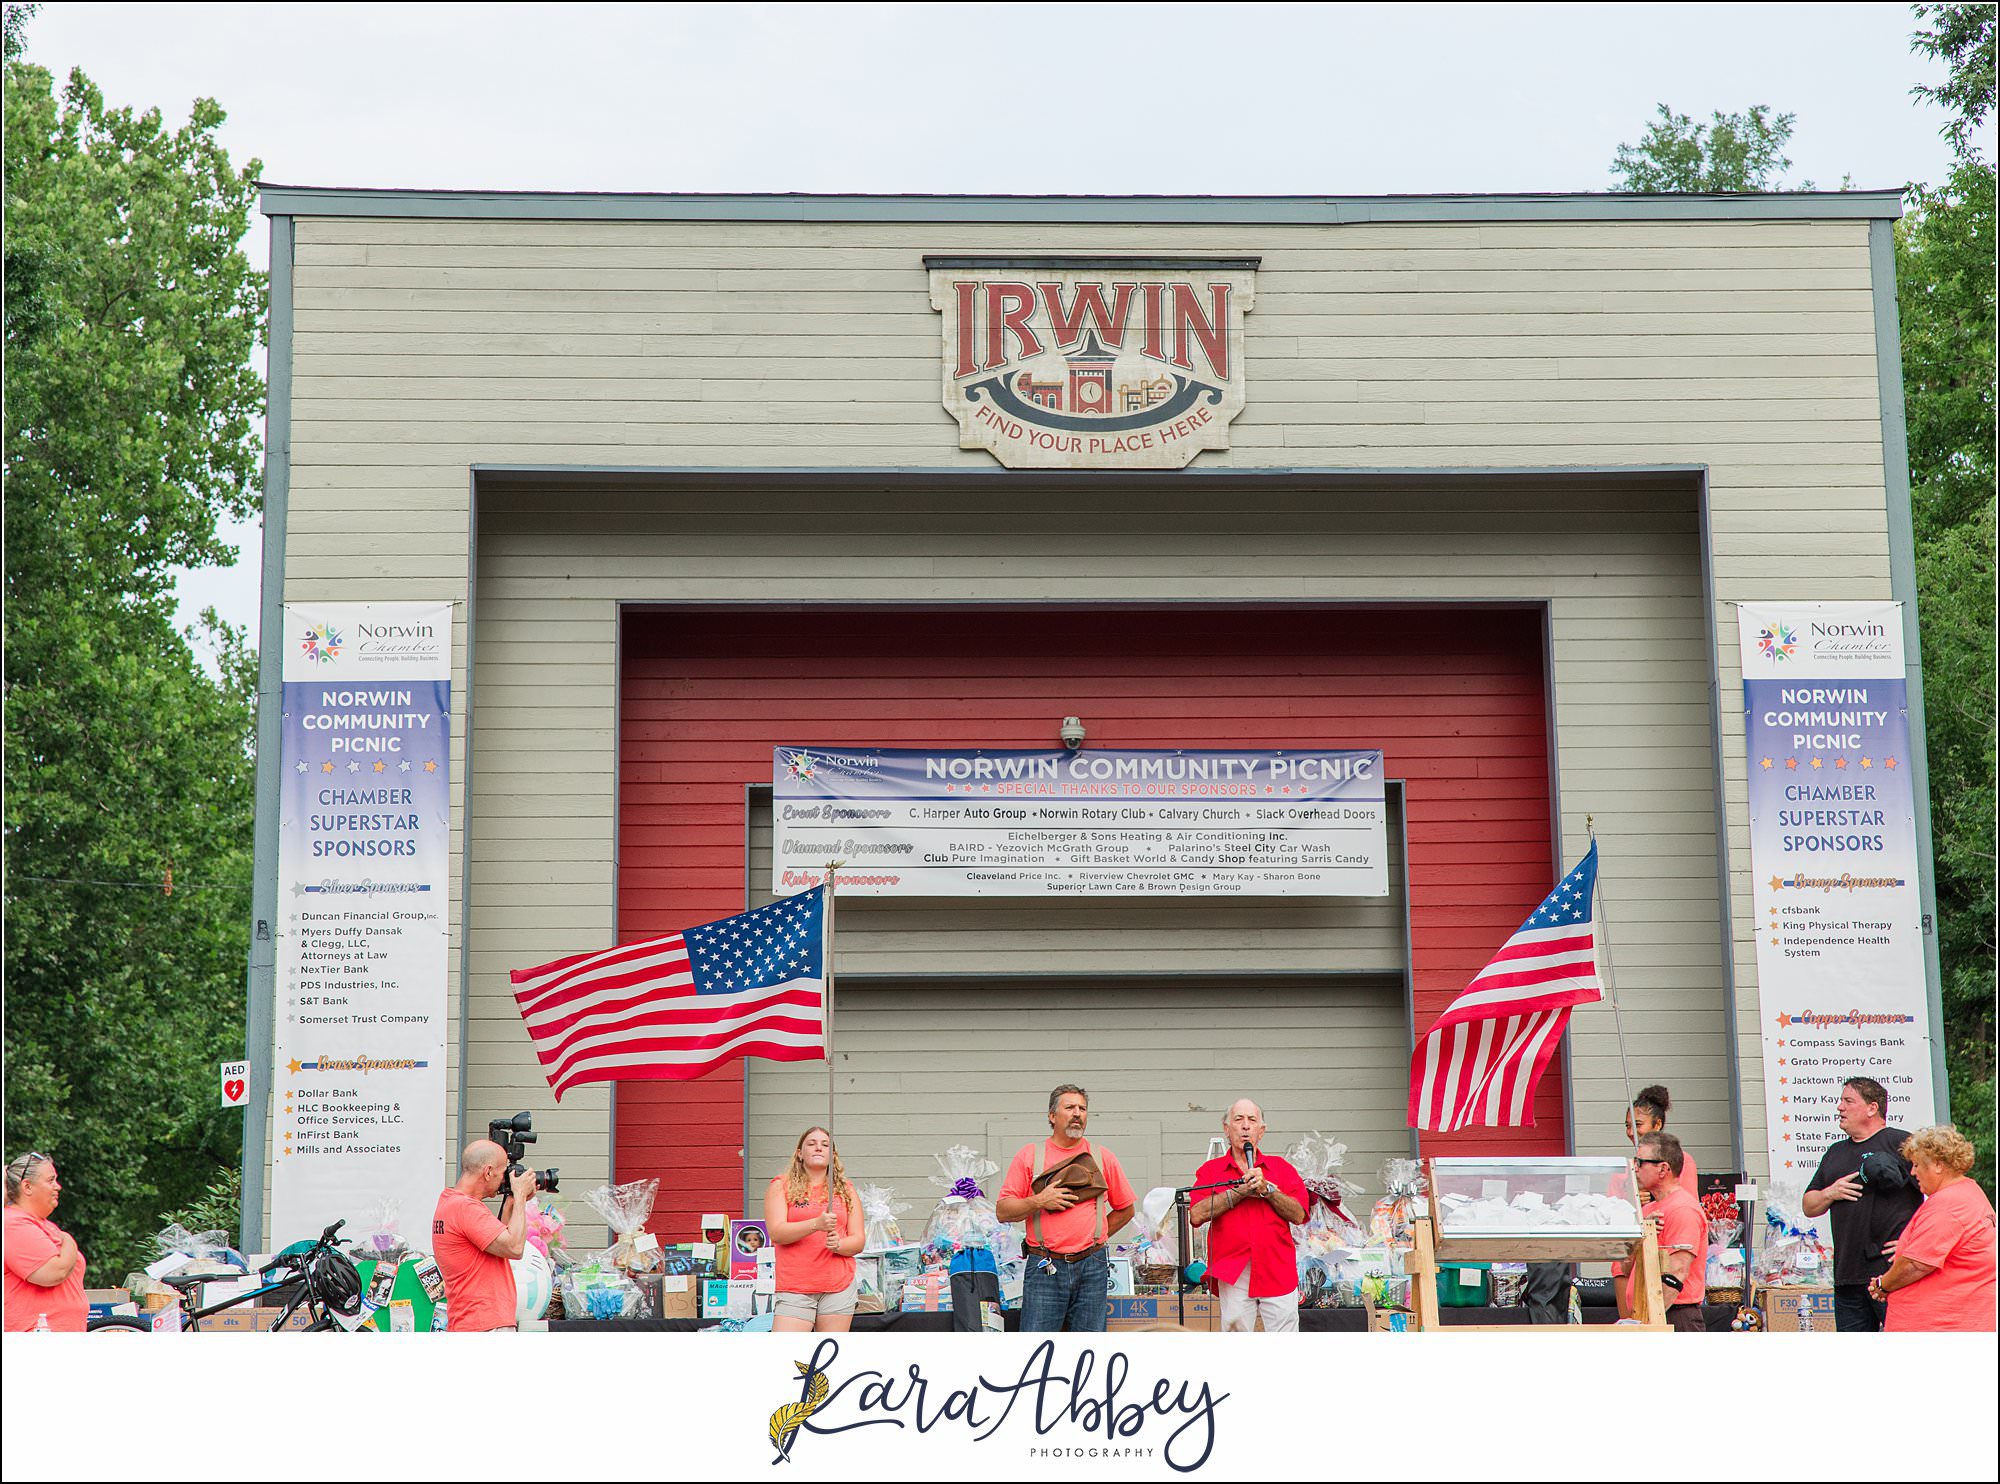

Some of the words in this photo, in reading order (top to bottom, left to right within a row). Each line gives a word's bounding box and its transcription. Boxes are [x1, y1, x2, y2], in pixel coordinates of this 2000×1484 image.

[952, 281, 1231, 380] IRWIN
[974, 404, 1023, 440] FIND
[1029, 429, 1082, 454] YOUR
[1089, 432, 1153, 455] PLACE
[1159, 406, 1213, 444] HERE
[358, 620, 434, 638] Norwin
[1811, 620, 1885, 637] Norwin
[322, 691, 411, 707] NORWIN
[1781, 688, 1868, 705] NORWIN
[302, 713, 431, 730] COMMUNITY
[1763, 711, 1888, 727] COMMUNITY
[331, 736, 401, 753] PICNIC
[1793, 734, 1862, 750] PICNIC
[826, 755, 879, 767] Norwin
[926, 758, 1058, 779] NORWIN
[1069, 758, 1258, 781] COMMUNITY
[1270, 758, 1374, 781] PICNIC
[997, 783, 1056, 795] SPECIAL
[1061, 783, 1117, 795] THANKS
[1122, 783, 1142, 795] TO
[1146, 784, 1178, 796] OUR
[1181, 784, 1257, 796] SPONSORS
[1784, 785, 1877, 801] CHAMBER
[318, 788, 413, 805] CHAMBER
[782, 804, 820, 821] Event
[909, 808, 919, 819] C.
[923, 808, 960, 821] Harper
[963, 808, 990, 819] Auto
[993, 808, 1027, 821] Group
[1039, 809, 1078, 819] Norwin
[1081, 808, 1118, 822] Rotary
[1121, 808, 1146, 820] Club
[1158, 808, 1199, 822] Calvary
[1202, 808, 1240, 820] Church
[1256, 808, 1285, 820] Slack
[1288, 808, 1340, 820] Overhead
[1344, 809, 1376, 820] Doors
[1779, 810, 1886, 827] SUPERSTAR
[310, 814, 420, 831] SUPERSTAR
[1008, 831, 1078, 843] Eichelberger
[1090, 832, 1117, 842] Sons
[1120, 831, 1162, 843] Heating
[1176, 831, 1193, 841] Air
[1195, 831, 1266, 843] Conditioning
[1269, 831, 1288, 841] Inc.
[312, 839, 416, 857] SPONSORS
[782, 839, 842, 855] Diamond
[949, 843, 985, 852] BAIRD
[996, 842, 1044, 852] Yezovich
[1047, 843, 1092, 853] McGrath
[1095, 844, 1129, 855] Group
[1168, 843, 1221, 853] Palarino's
[1224, 843, 1251, 853] Steel
[1254, 843, 1276, 855] City
[1279, 844, 1298, 853] Car
[1301, 843, 1331, 853] Wash
[1783, 835, 1884, 852] SPONSORS
[924, 853, 948, 863] Club
[952, 854, 977, 863] Pure
[980, 853, 1045, 865] Imagination
[1070, 853, 1090, 863] Gift
[1094, 853, 1130, 864] Basket
[1133, 853, 1167, 864] World
[1181, 853, 1214, 866] Candy
[1218, 853, 1246, 865] Shop
[1248, 853, 1298, 865] featuring
[1301, 854, 1332, 864] Sarris
[1335, 853, 1369, 865] Candy
[781, 871, 819, 888] Ruby
[966, 872, 1016, 881] Cleaveland
[1019, 872, 1042, 881] Price
[1045, 872, 1061, 881] Inc.
[1079, 872, 1124, 881] Riverview
[1126, 871, 1171, 881] Chevrolet
[1173, 872, 1195, 881] GMC
[1212, 872, 1234, 883] Mary
[1237, 872, 1254, 883] Kay
[1263, 872, 1295, 881] Sharon
[1297, 872, 1321, 881] Bone
[1793, 873, 1840, 894] Bronze
[1840, 872, 1898, 893] Sponsors
[319, 878, 360, 896] Silver
[361, 877, 421, 898] Sponsors
[1047, 883, 1086, 893] Superior
[1088, 882, 1113, 892] Lawn
[1115, 882, 1136, 892] Care
[1147, 882, 1177, 892] Brown
[1179, 882, 1211, 894] Design
[1213, 882, 1241, 894] Group
[301, 911, 340, 921] Duncan
[343, 911, 389, 921] Financial
[1782, 905, 1821, 915] cfsbank
[301, 928, 331, 937] Myers
[334, 927, 362, 937] Duffy
[365, 926, 403, 936] Dansak
[1783, 921, 1806, 931] King
[1809, 921, 1849, 931] Physical
[1852, 920, 1893, 931] Therapy
[311, 939, 345, 950] Clegg,
[348, 939, 370, 950] LLC,
[1783, 936, 1855, 947] Independence
[1858, 936, 1890, 945] Health
[301, 951, 351, 961] Attorneys
[354, 952, 364, 960] at
[367, 950, 388, 960] Law
[1784, 948, 1821, 959] System
[301, 965, 341, 974] NexTier
[344, 964, 369, 974] Bank
[300, 980, 321, 990] PDS
[324, 979, 378, 990] Industries,
[381, 979, 399, 989] Inc.
[300, 996, 319, 1006] S&T
[323, 996, 348, 1005] Bank
[299, 1014, 349, 1024] Somerset
[352, 1014, 377, 1024] Trust
[380, 1013, 429, 1025] Company
[1800, 1009, 1847, 1030] Copper
[1848, 1008, 1908, 1030] Sponsors
[1789, 1038, 1836, 1049] Compass
[1838, 1038, 1877, 1049] Savings
[1880, 1037, 1905, 1047] Bank
[316, 1054, 356, 1072] Brass
[356, 1054, 417, 1076] Sponsors
[1790, 1057, 1819, 1067] Grato
[1822, 1057, 1866, 1068] Property
[1869, 1056, 1893, 1066] Care
[224, 1064, 245, 1076] AED
[1791, 1075, 1835, 1085] Jacktown
[1892, 1075, 1913, 1084] Club
[298, 1089, 329, 1098] Dollar
[332, 1088, 358, 1098] Bank
[1793, 1095, 1817, 1104] Mary
[1820, 1094, 1839, 1104] Kay
[297, 1103, 318, 1113] HLC
[322, 1102, 390, 1114] Bookkeeping
[297, 1115, 329, 1125] Office
[332, 1114, 378, 1126] Services,
[381, 1114, 404, 1124] LLC.
[1794, 1114, 1830, 1122] Norwin
[297, 1131, 331, 1140] InFirst
[334, 1130, 359, 1139] Bank
[1795, 1132, 1821, 1141] State
[297, 1145, 320, 1154] Mills
[323, 1145, 342, 1154] and
[345, 1144, 401, 1153] Associates
[1129, 1300, 1148, 1313] 4K
[1193, 1304, 1209, 1312] dts
[1780, 1298, 1798, 1308] F30
[223, 1318, 239, 1326] dts
[291, 1316, 307, 1326] 50
